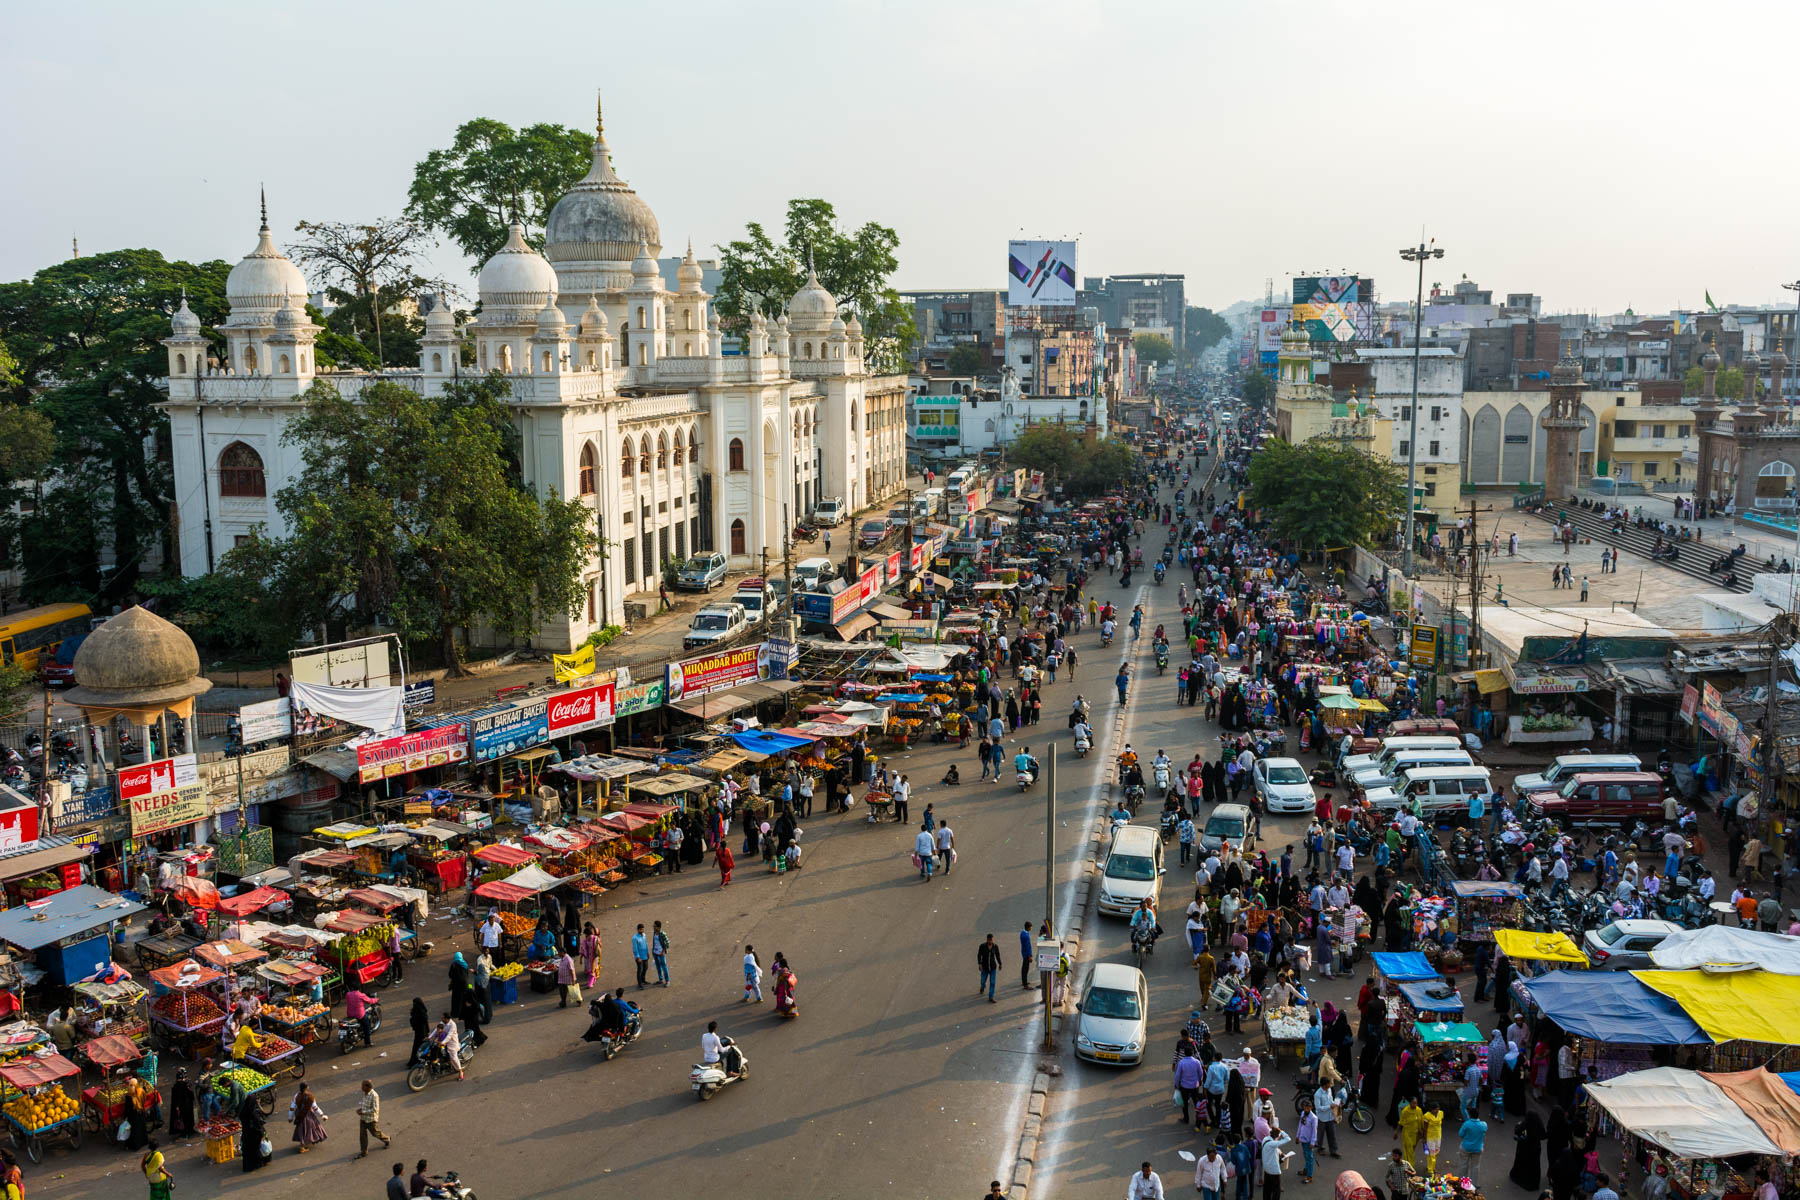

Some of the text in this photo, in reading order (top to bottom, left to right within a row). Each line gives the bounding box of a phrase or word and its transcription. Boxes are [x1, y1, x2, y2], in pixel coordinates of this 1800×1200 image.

[684, 650, 757, 676] MUQADDAR HOTEL
[552, 695, 594, 722] Coca-Cola
[625, 697, 644, 708] SHOP
[475, 718, 493, 734] ABUL
[494, 709, 522, 728] BARKAAT
[523, 702, 548, 719] BAKERY
[364, 743, 417, 762] SADDAM
[419, 733, 462, 751] HOTEL
[122, 774, 149, 788] Coca-Cola
[133, 786, 203, 814] NEEDS GENERAL
[182, 793, 200, 802] STORE
[154, 807, 170, 817] COOL
[172, 803, 191, 812] POINT
[17, 842, 34, 851] SHOP
